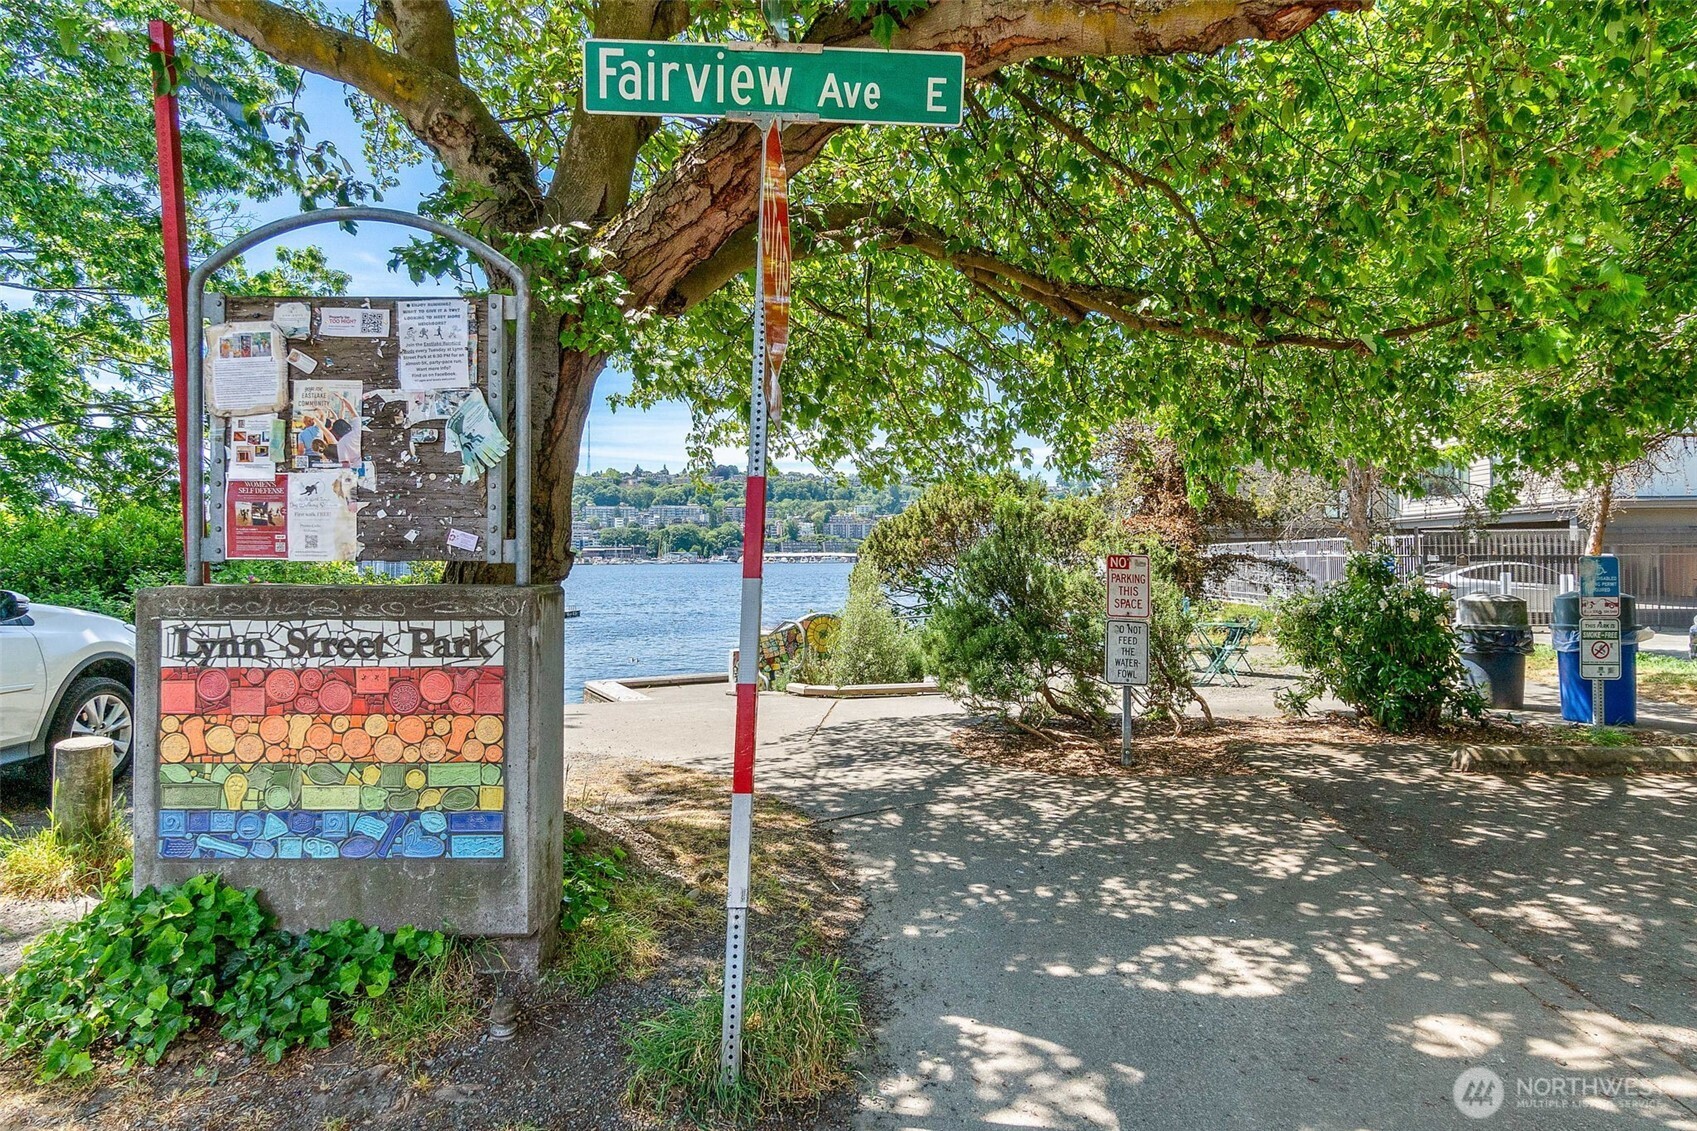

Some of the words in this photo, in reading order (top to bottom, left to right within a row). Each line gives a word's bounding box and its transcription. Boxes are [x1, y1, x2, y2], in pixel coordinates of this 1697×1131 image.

[599, 47, 793, 106] Fairview
[816, 72, 881, 110] Ave
[926, 76, 947, 112] E
[1110, 556, 1127, 568] NO
[1111, 573, 1146, 584] PARKING
[1118, 585, 1139, 597] THIS
[1114, 598, 1143, 610] SPACE
[1127, 625, 1142, 635] NOT
[1582, 631, 1618, 639] SMOKE-FREE
[1118, 636, 1138, 645] FEED
[175, 627, 268, 666] Lynn
[285, 627, 391, 659] Street
[408, 626, 495, 659] Park
[1121, 647, 1136, 656] THE
[1114, 658, 1141, 668] WATER-
[1117, 669, 1138, 679] FOWL
